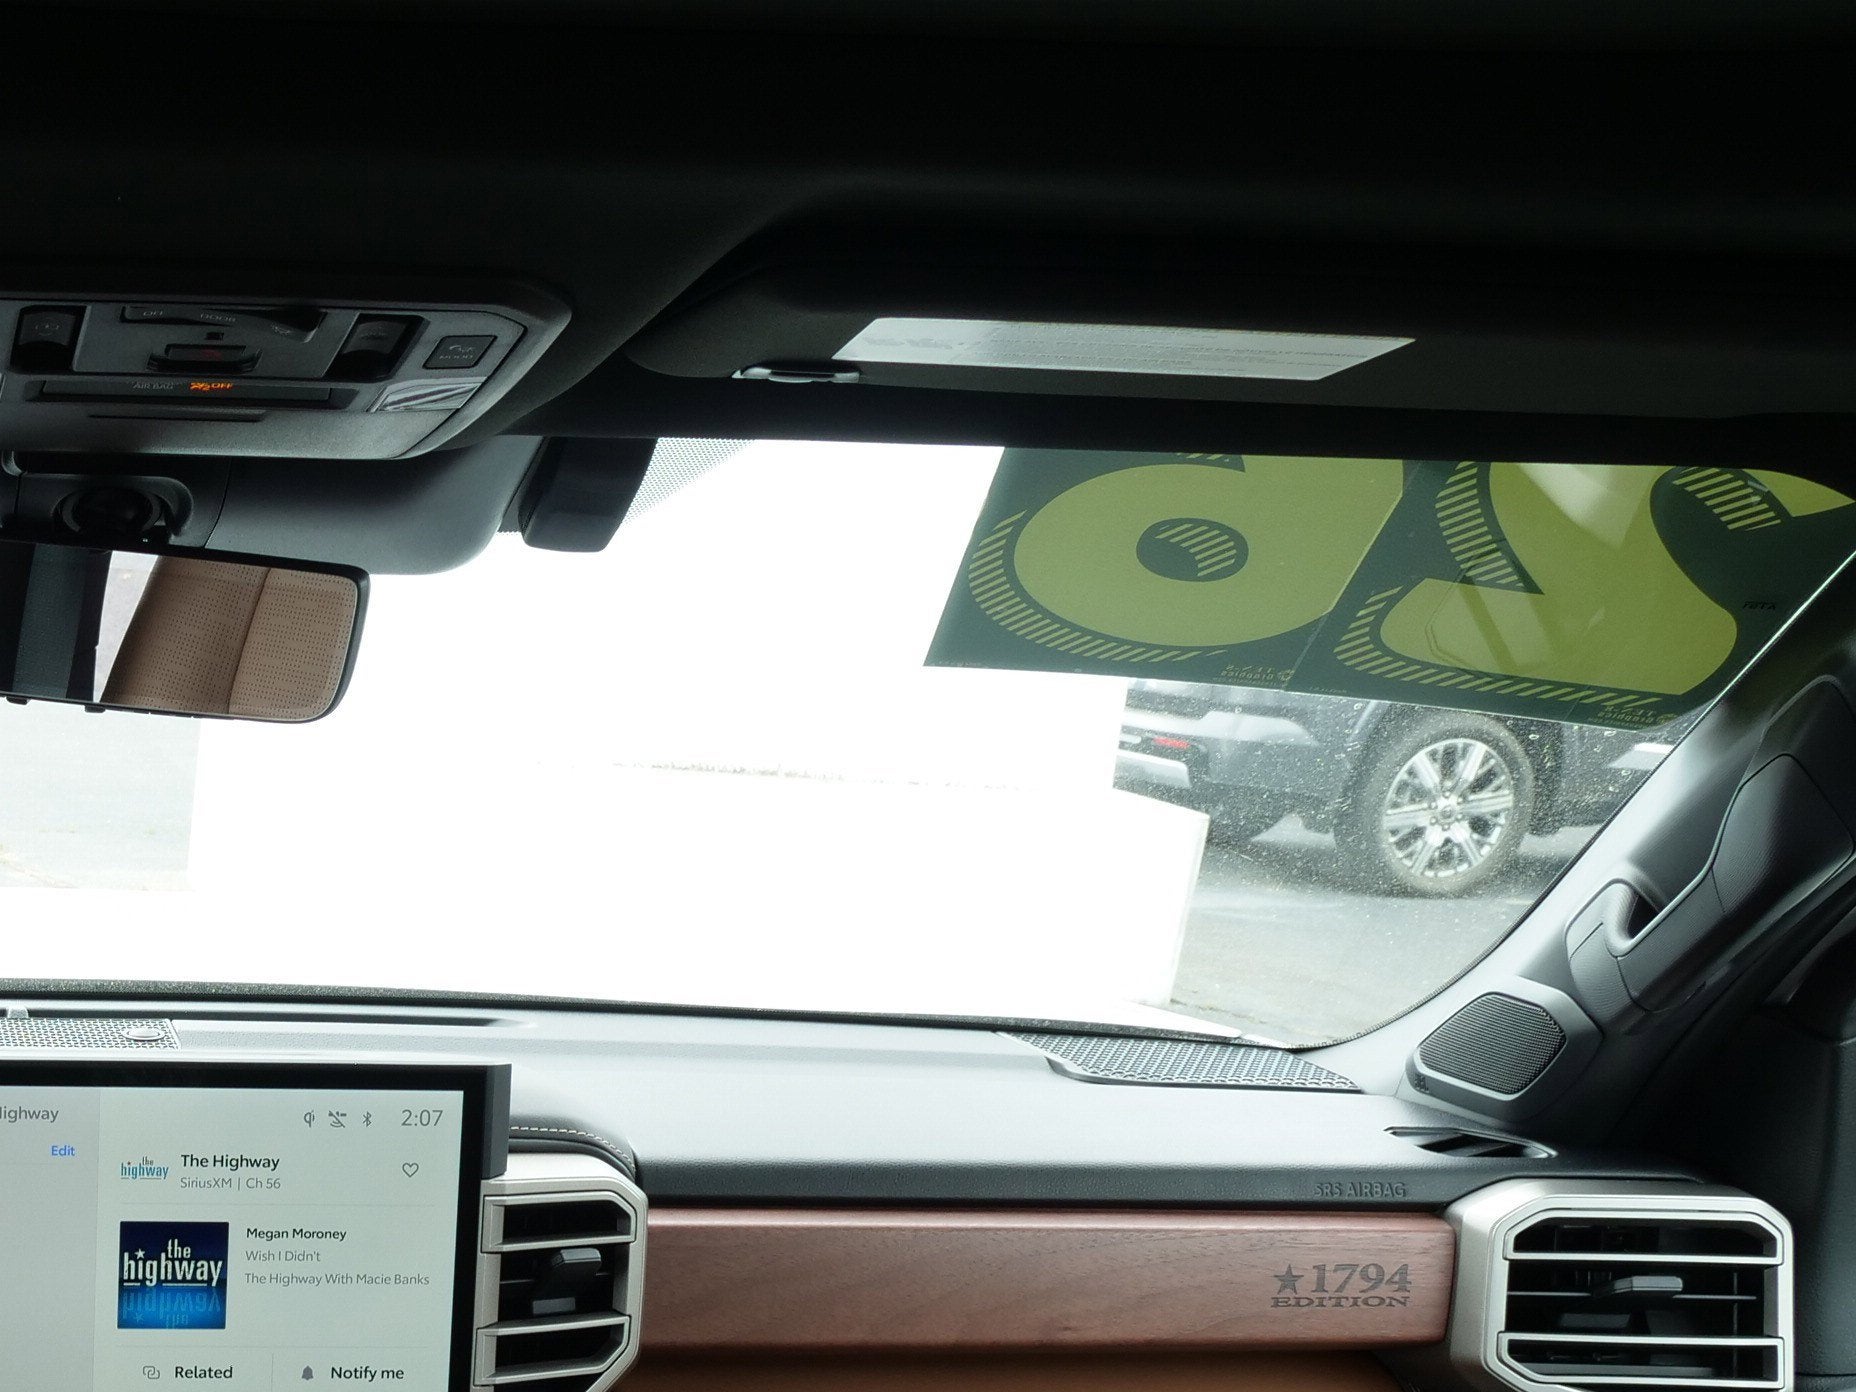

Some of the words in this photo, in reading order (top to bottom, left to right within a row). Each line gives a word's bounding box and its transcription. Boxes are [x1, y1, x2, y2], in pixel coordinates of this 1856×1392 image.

[401, 1109, 443, 1127] 2:07
[51, 1145, 75, 1157] Edit
[142, 1156, 154, 1166] the
[181, 1154, 209, 1169] The
[213, 1155, 280, 1171] Highway
[120, 1162, 169, 1179] highway
[180, 1177, 233, 1190] SiriusXM
[246, 1177, 263, 1190] Ch
[265, 1177, 281, 1190] 56
[1315, 1182, 1341, 1197] SRS
[1346, 1182, 1406, 1197] AIRBAG
[246, 1228, 289, 1241] Megan
[292, 1228, 347, 1241] Moroney
[167, 1239, 192, 1259] the
[245, 1250, 275, 1262] Wish
[284, 1250, 321, 1262] Didn't
[123, 1251, 222, 1287] highway
[244, 1273, 267, 1285] The
[269, 1273, 322, 1287] Highway
[325, 1273, 353, 1285] With
[356, 1273, 391, 1285] Macie
[394, 1274, 429, 1286] Banks
[1312, 1263, 1412, 1293] 1794
[1271, 1296, 1410, 1308] EDITION
[175, 1366, 233, 1379] Related
[330, 1366, 377, 1382] Notify
[381, 1369, 404, 1379] me
